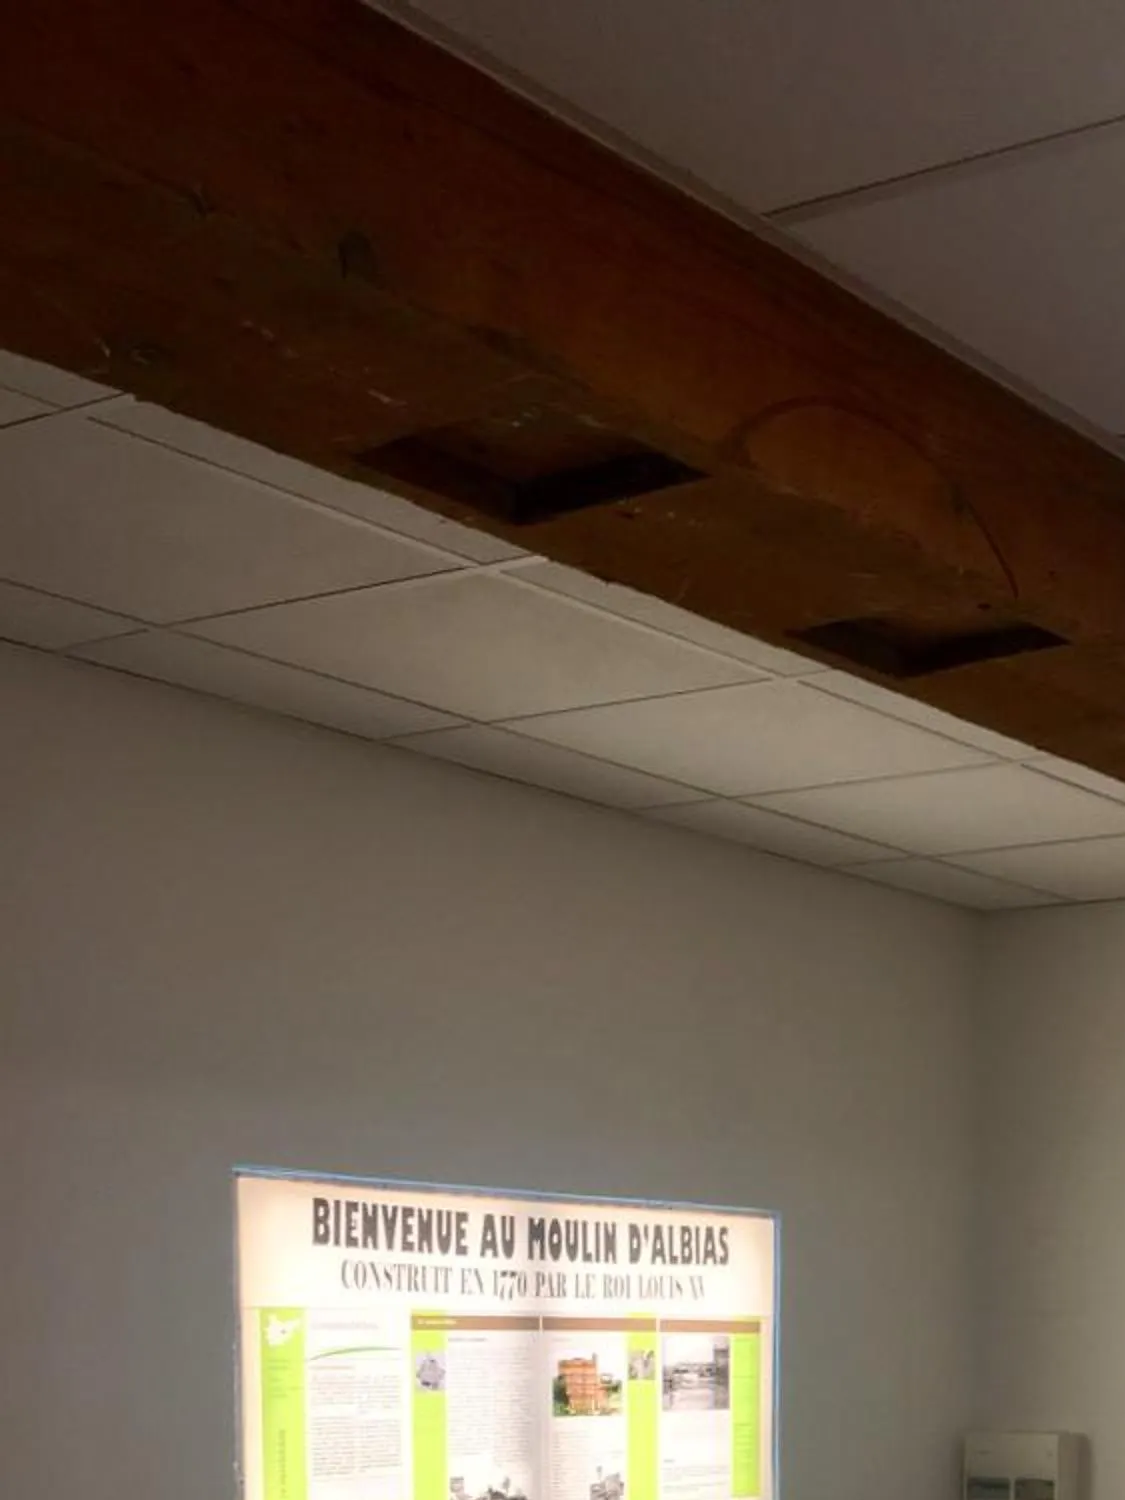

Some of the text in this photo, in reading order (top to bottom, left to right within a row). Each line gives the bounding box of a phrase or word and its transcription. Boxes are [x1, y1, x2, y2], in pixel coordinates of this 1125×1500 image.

[312, 1197, 730, 1266] BIENVENUE AU MOULIN D'ALBIAS
[341, 1258, 452, 1293] CONSTRUIT
[461, 1267, 485, 1296] EN
[493, 1270, 528, 1301] 1770
[535, 1271, 567, 1299] PAR
[574, 1273, 595, 1300] LE
[603, 1273, 631, 1300] ROI
